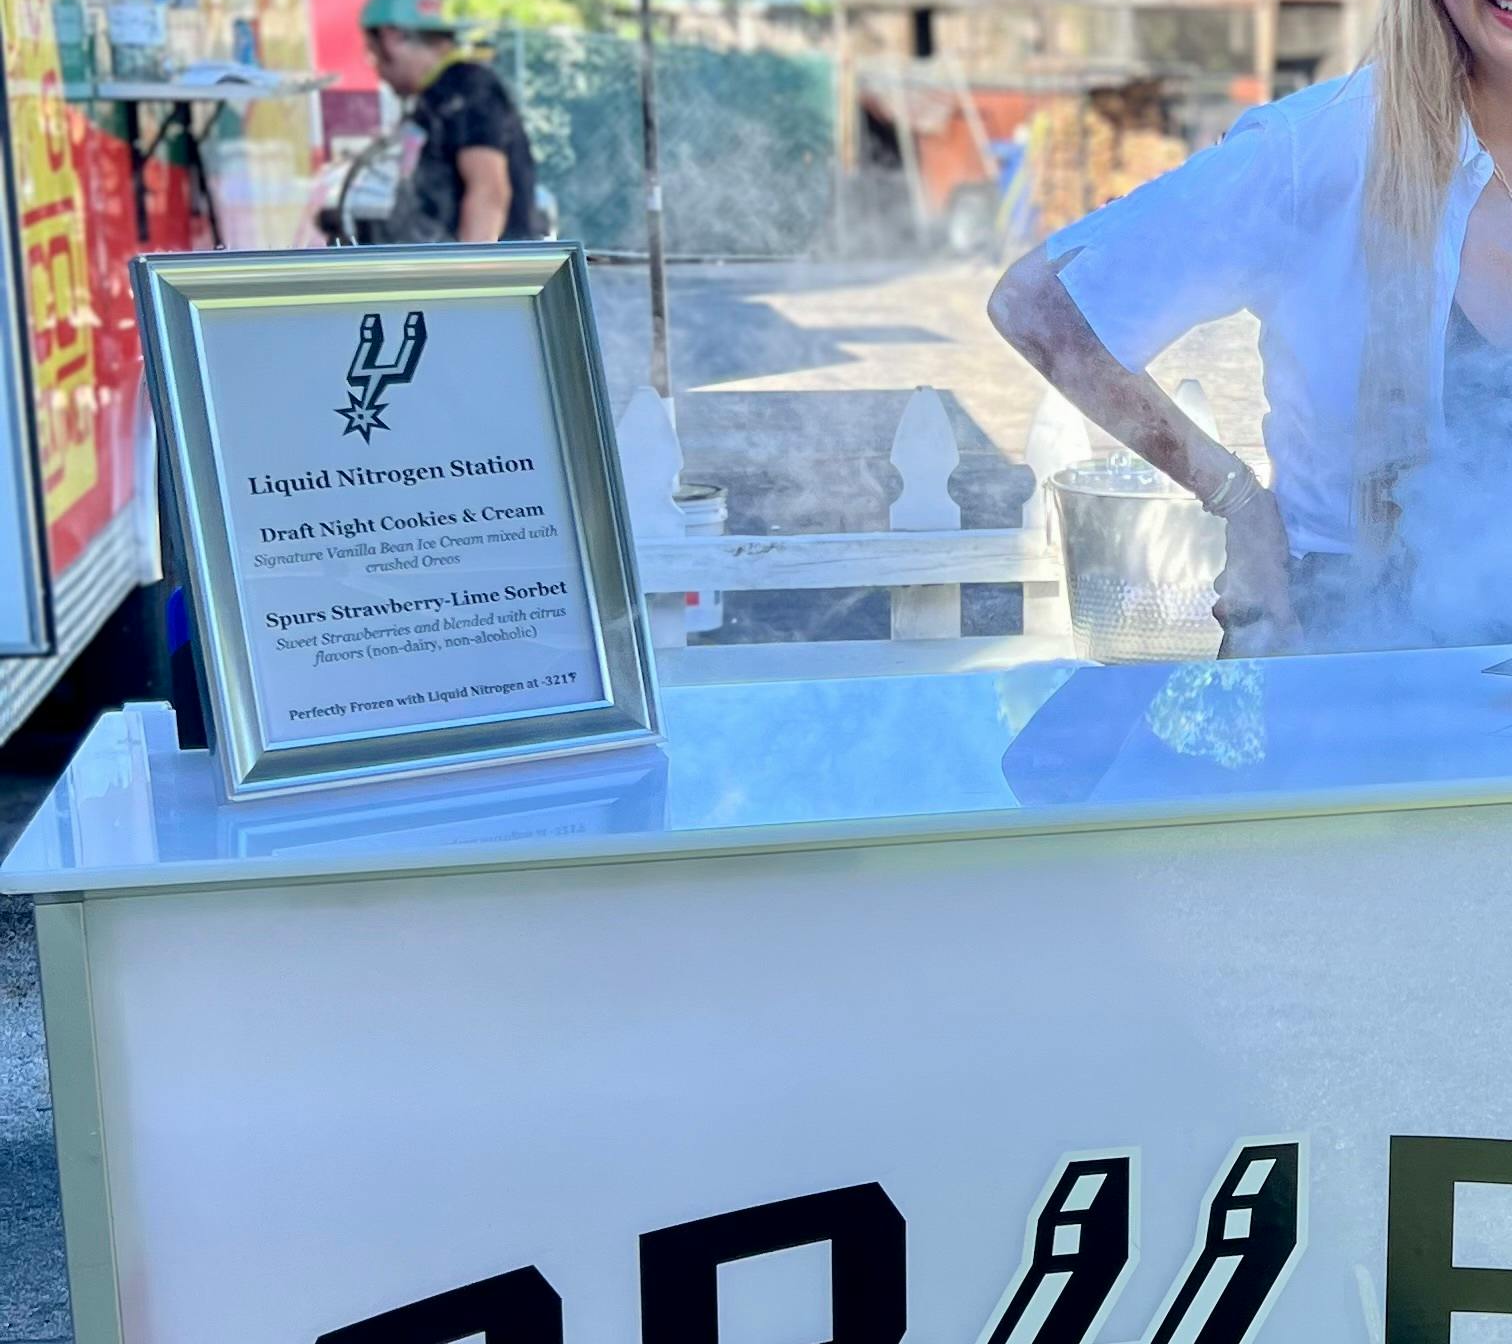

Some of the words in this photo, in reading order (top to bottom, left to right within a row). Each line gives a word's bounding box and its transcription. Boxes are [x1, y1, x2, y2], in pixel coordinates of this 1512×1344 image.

[248, 469, 333, 497] Liquid
[336, 466, 445, 488] Nitrogen
[450, 456, 536, 478] Station
[260, 522, 315, 543] Draft
[319, 518, 377, 539] Night
[380, 511, 458, 531] Cookies
[462, 508, 478, 523] &
[481, 505, 545, 521] Cream
[254, 551, 324, 569] Signature
[326, 543, 376, 559] Vanilla
[380, 541, 414, 554] Bean
[417, 538, 437, 550] Ice
[440, 535, 485, 549] Cream
[486, 528, 526, 543] mixed
[529, 524, 559, 539] with
[366, 555, 418, 574] crushed
[422, 554, 461, 568] Oreos
[266, 610, 327, 631] Spurs
[331, 590, 500, 621] Strawberry-Lime
[504, 581, 568, 601] Sorbet
[276, 636, 317, 651] Sweet
[322, 624, 411, 645] Strawberries
[414, 618, 440, 634] and
[443, 612, 495, 631] blended
[497, 610, 527, 624] with
[529, 607, 567, 620] citrus
[312, 649, 364, 667] flavors
[367, 639, 442, 660] (non-dairy,
[445, 625, 537, 648] non-alcoholic)
[289, 703, 347, 721] Perfectly
[350, 699, 394, 713] Frozen
[396, 693, 425, 706] with
[428, 687, 469, 703] Liquid
[470, 680, 524, 697] Nitrogen
[527, 678, 540, 689] at
